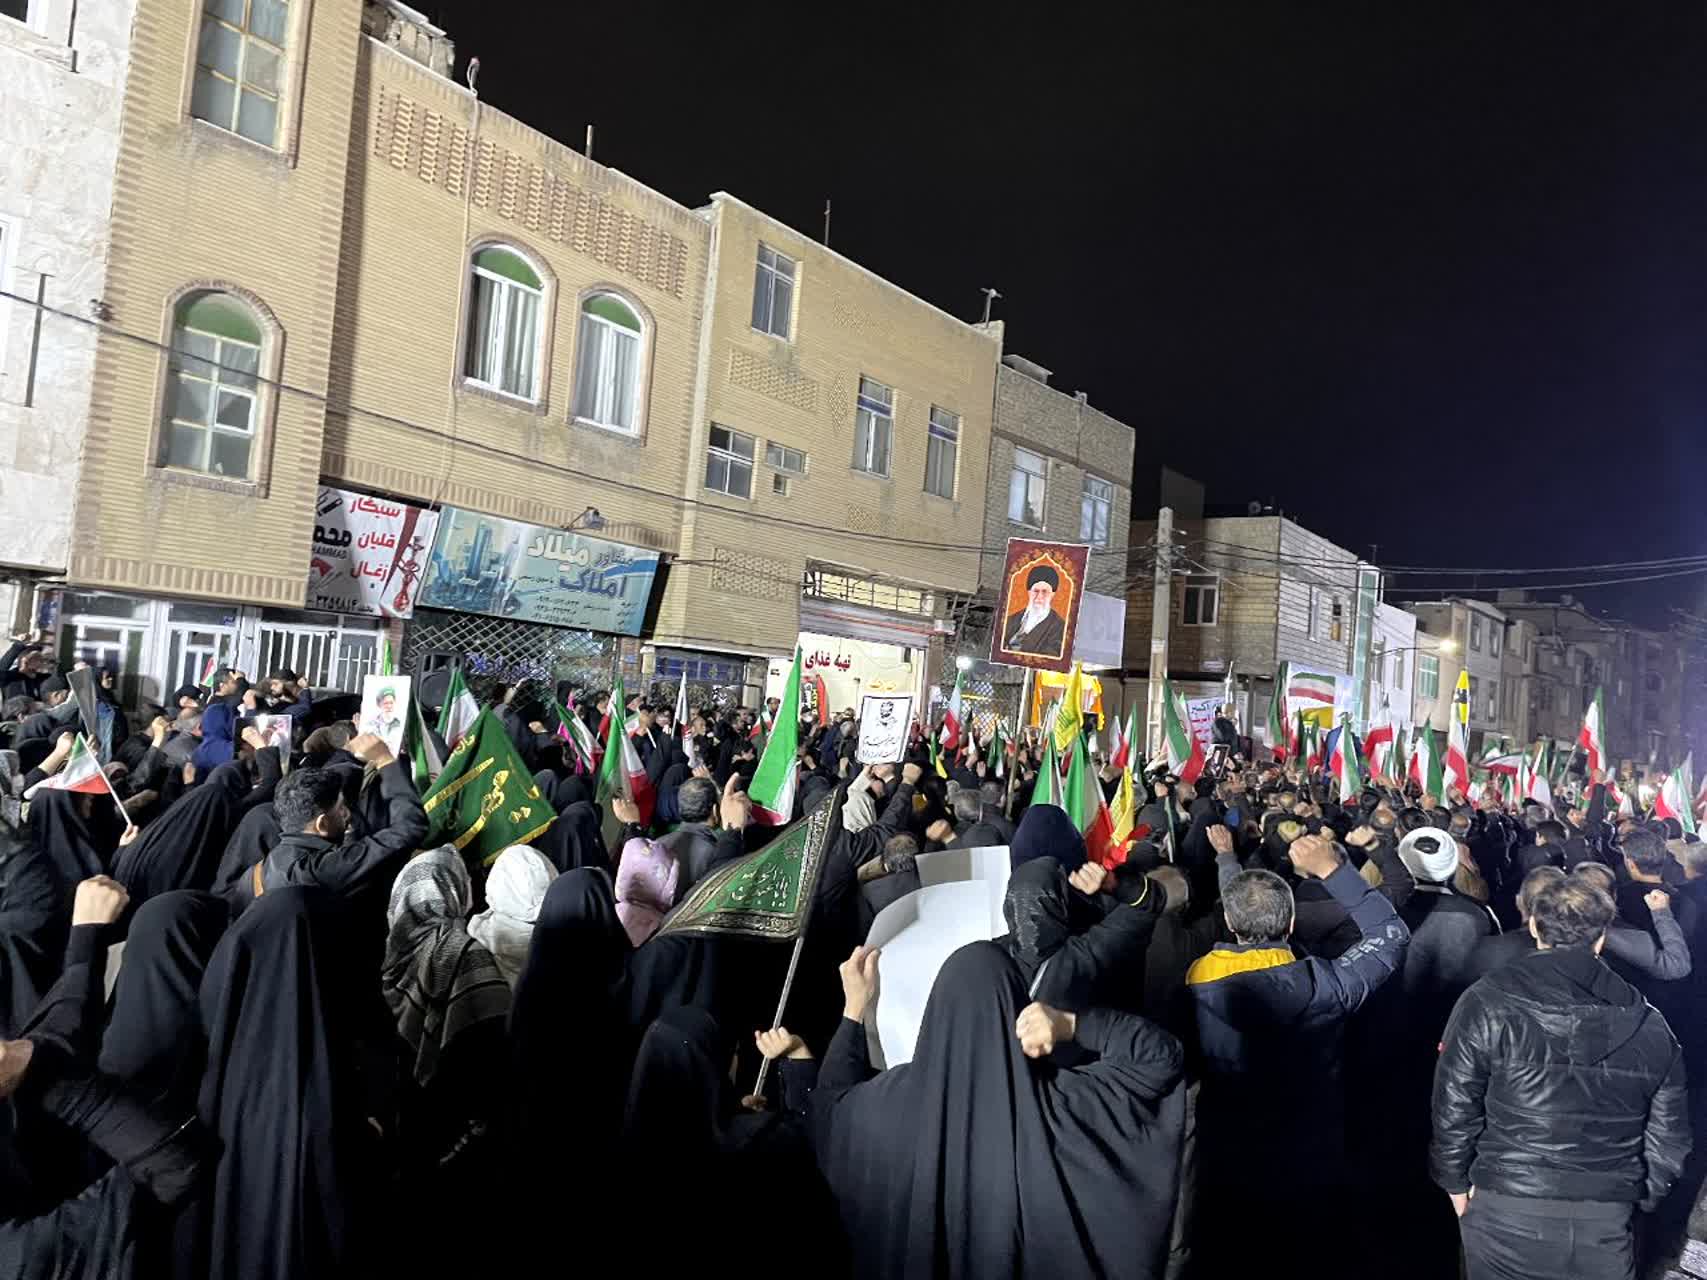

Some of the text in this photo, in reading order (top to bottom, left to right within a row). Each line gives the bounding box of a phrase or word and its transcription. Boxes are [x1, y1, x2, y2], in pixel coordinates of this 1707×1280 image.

[314, 525, 352, 547] محم
[358, 532, 395, 549] قلیان
[528, 535, 589, 571] میلاد
[351, 561, 388, 581] زغال
[560, 568, 627, 597] املاک
[805, 651, 852, 672] تهیه غذای
